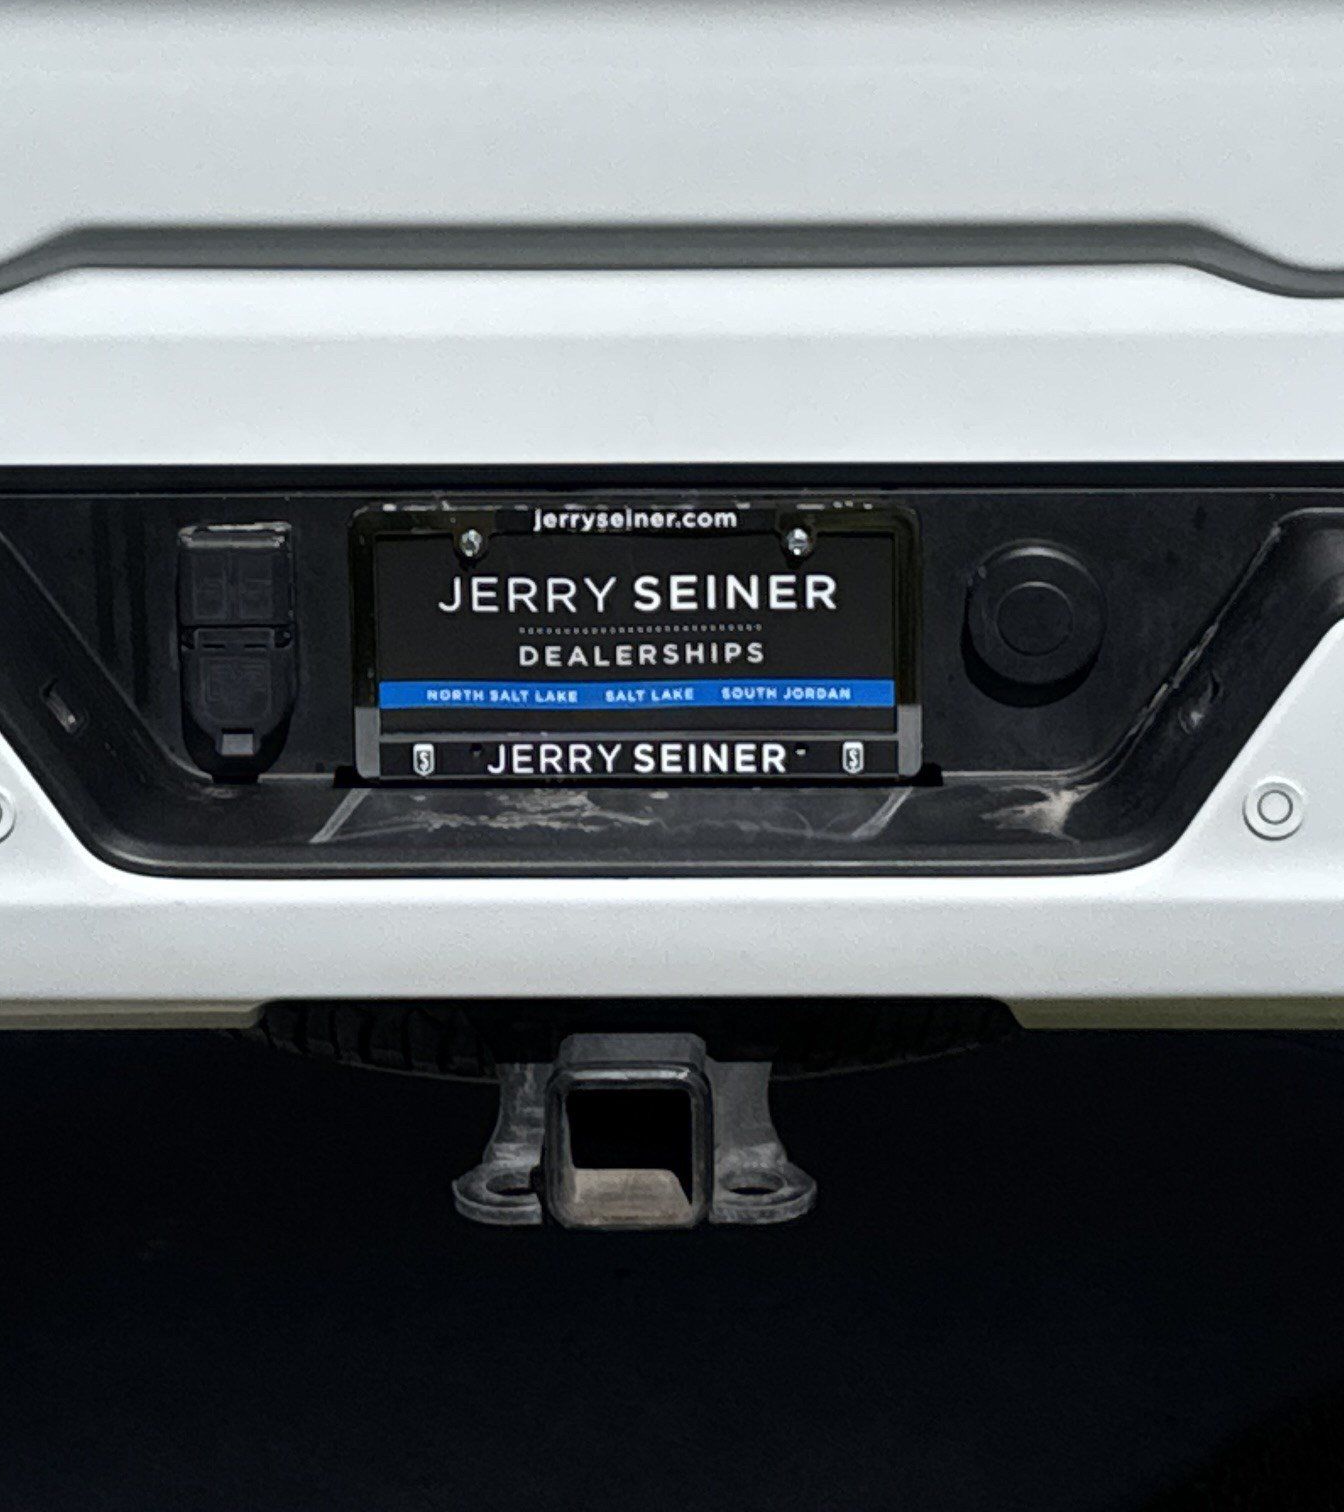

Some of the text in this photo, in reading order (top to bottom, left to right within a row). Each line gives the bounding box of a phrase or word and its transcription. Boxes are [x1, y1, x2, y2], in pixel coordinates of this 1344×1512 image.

[534, 507, 738, 533] jerryseiner.com
[438, 574, 838, 614] JERRY SEINER
[519, 642, 765, 668] DEALERSHIPS
[426, 689, 579, 703] NORTH SALT LAKE
[605, 688, 695, 703] SALT LAKE
[721, 687, 852, 701] SOUTH JORDAN
[487, 742, 788, 775] JERRY SEINER
